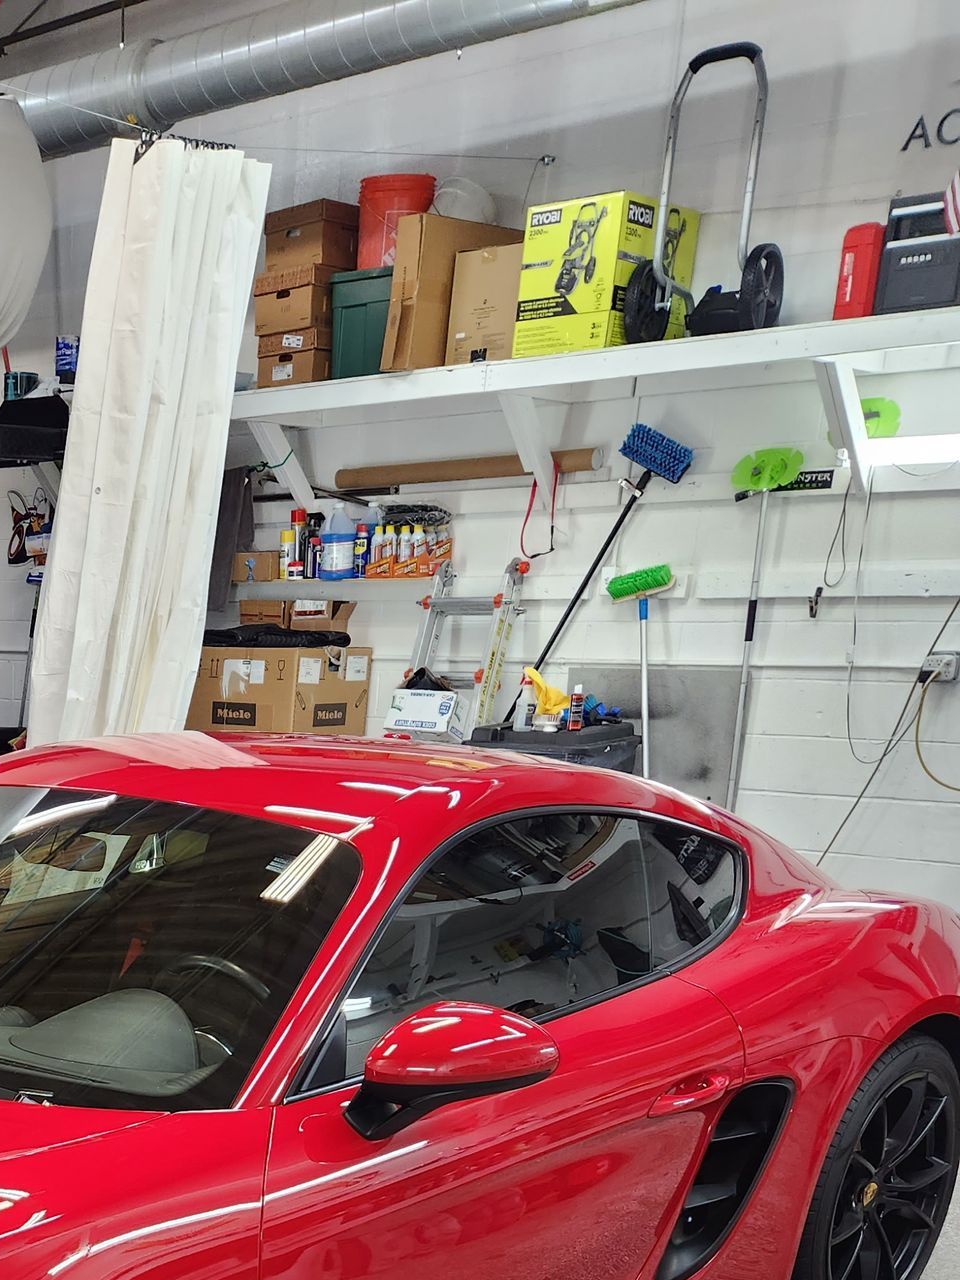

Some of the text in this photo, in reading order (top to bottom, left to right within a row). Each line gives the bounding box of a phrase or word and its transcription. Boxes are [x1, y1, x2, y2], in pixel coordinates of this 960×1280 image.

[531, 210, 561, 227] RYOBI
[628, 204, 654, 225] RYOBI
[217, 708, 251, 720] Miele
[317, 710, 343, 721] Miele
